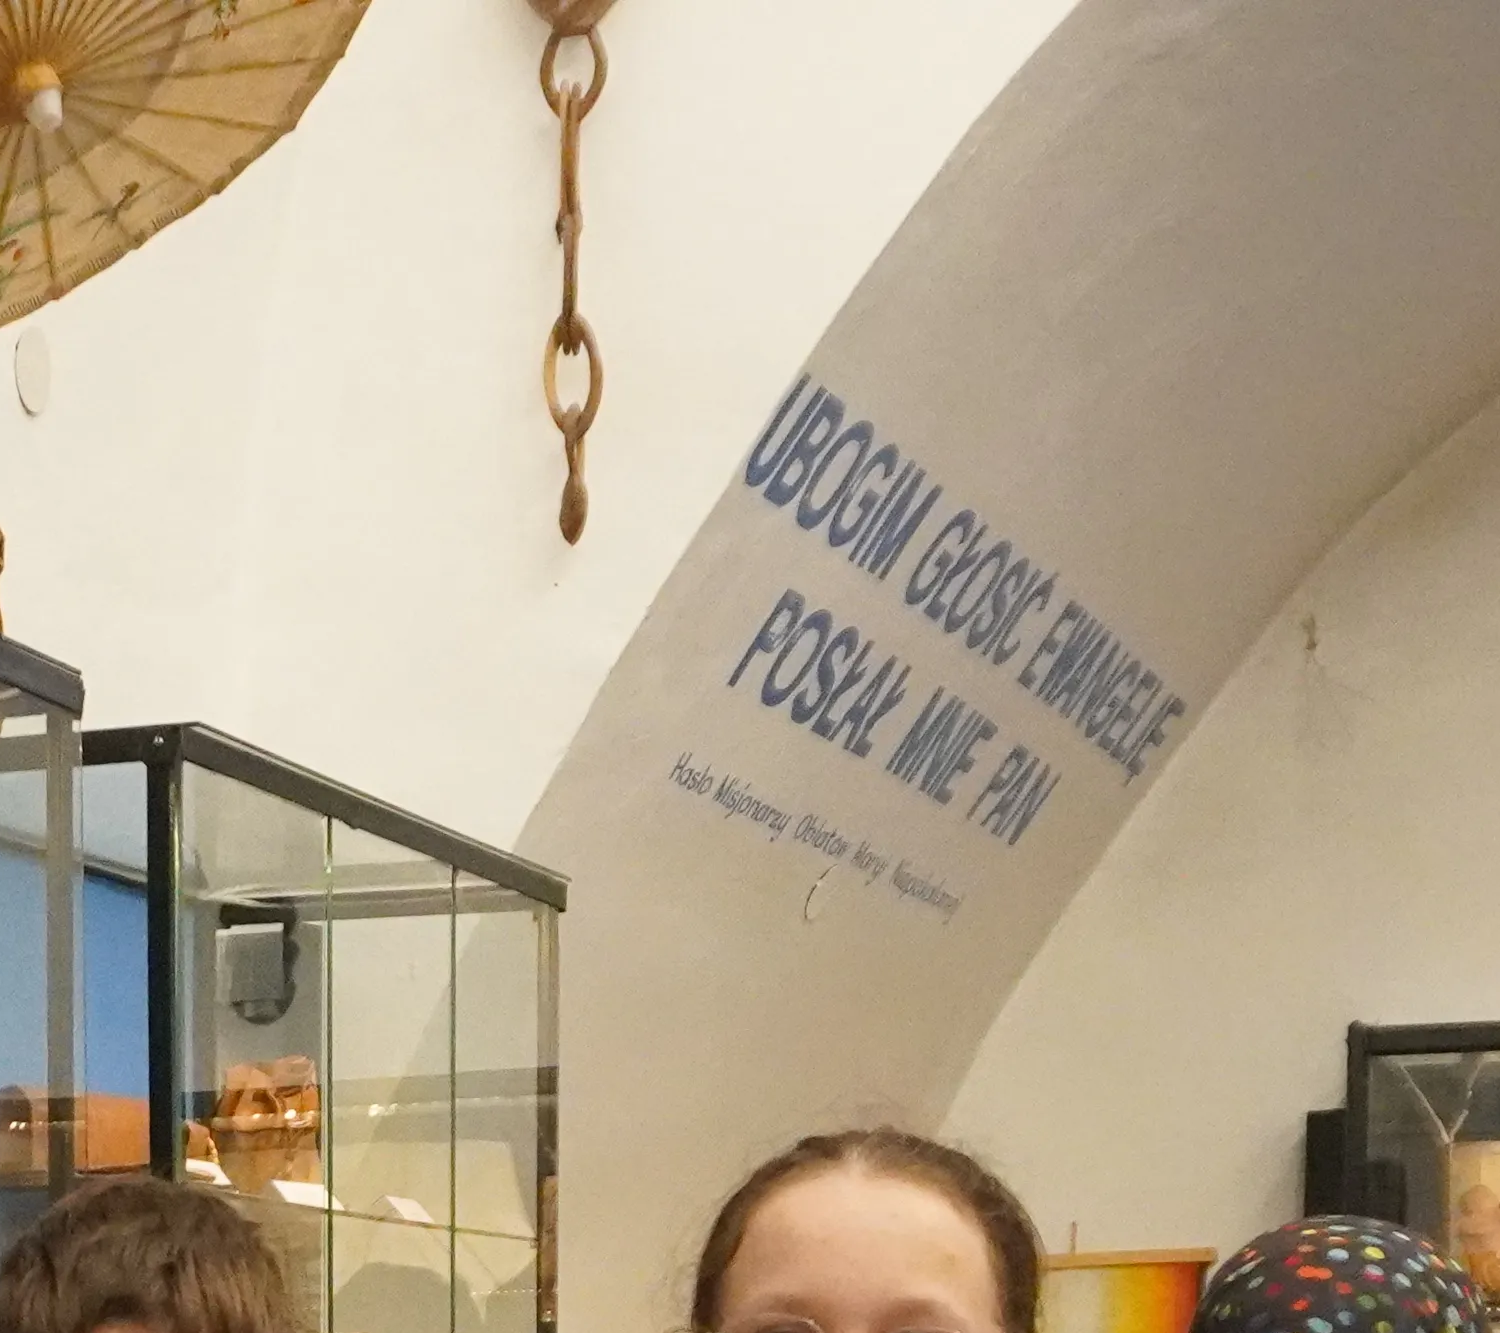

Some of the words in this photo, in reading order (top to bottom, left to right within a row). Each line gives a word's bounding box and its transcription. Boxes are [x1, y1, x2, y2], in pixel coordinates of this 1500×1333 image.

[745, 372, 944, 580] UBOGIM
[905, 509, 1060, 665] GŁOSIĆ
[728, 588, 912, 758] POSŁAŁ
[885, 685, 998, 806] MNIE
[966, 744, 1062, 846] PAN
